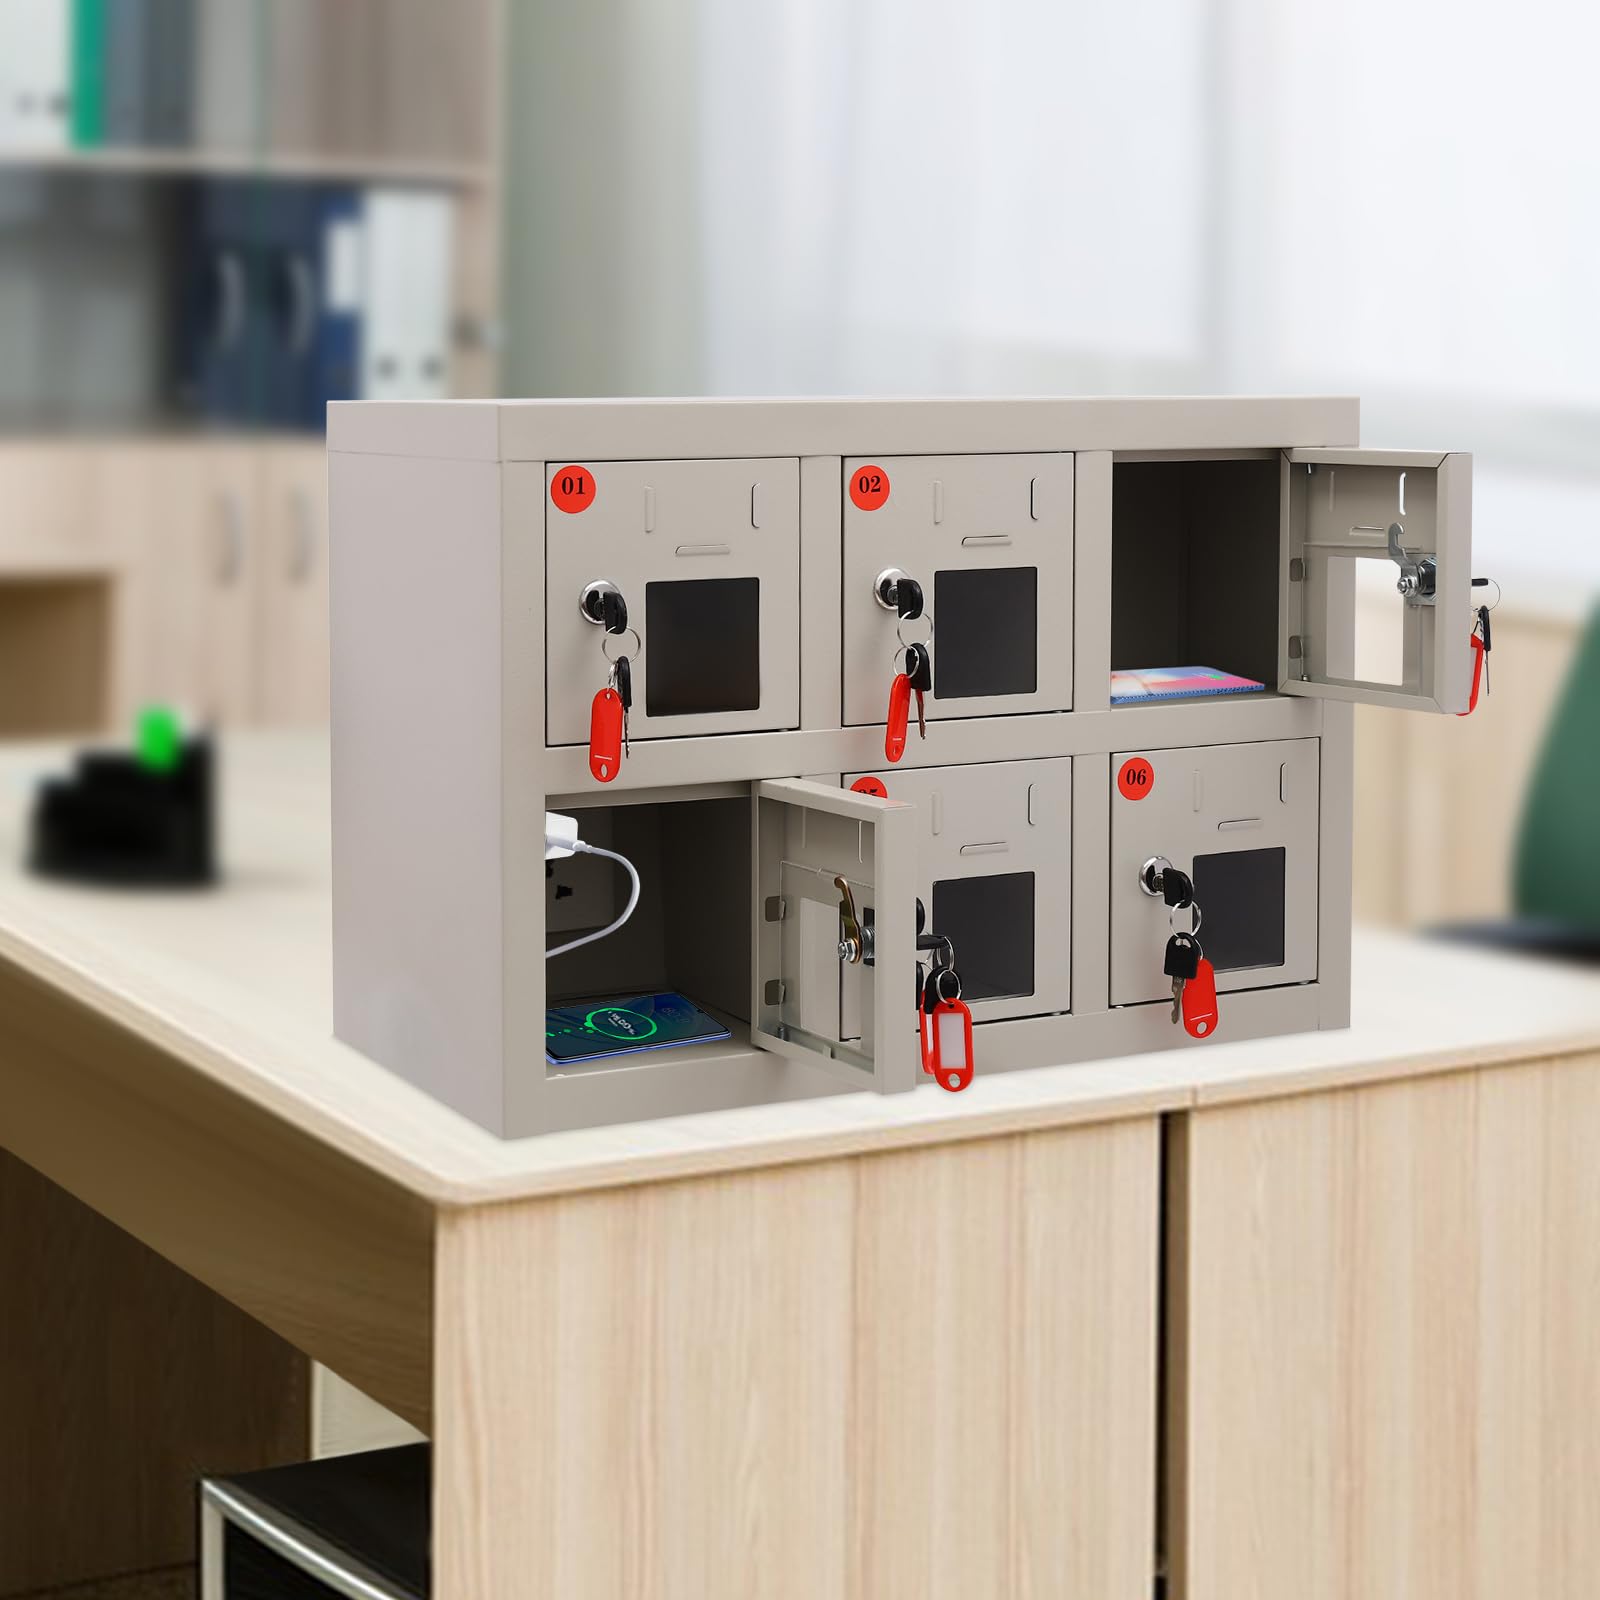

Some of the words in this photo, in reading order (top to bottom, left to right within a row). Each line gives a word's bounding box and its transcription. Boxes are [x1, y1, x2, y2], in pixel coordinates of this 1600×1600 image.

[561, 476, 585, 495] 01
[859, 475, 881, 494] 02
[1126, 768, 1147, 786] 06
